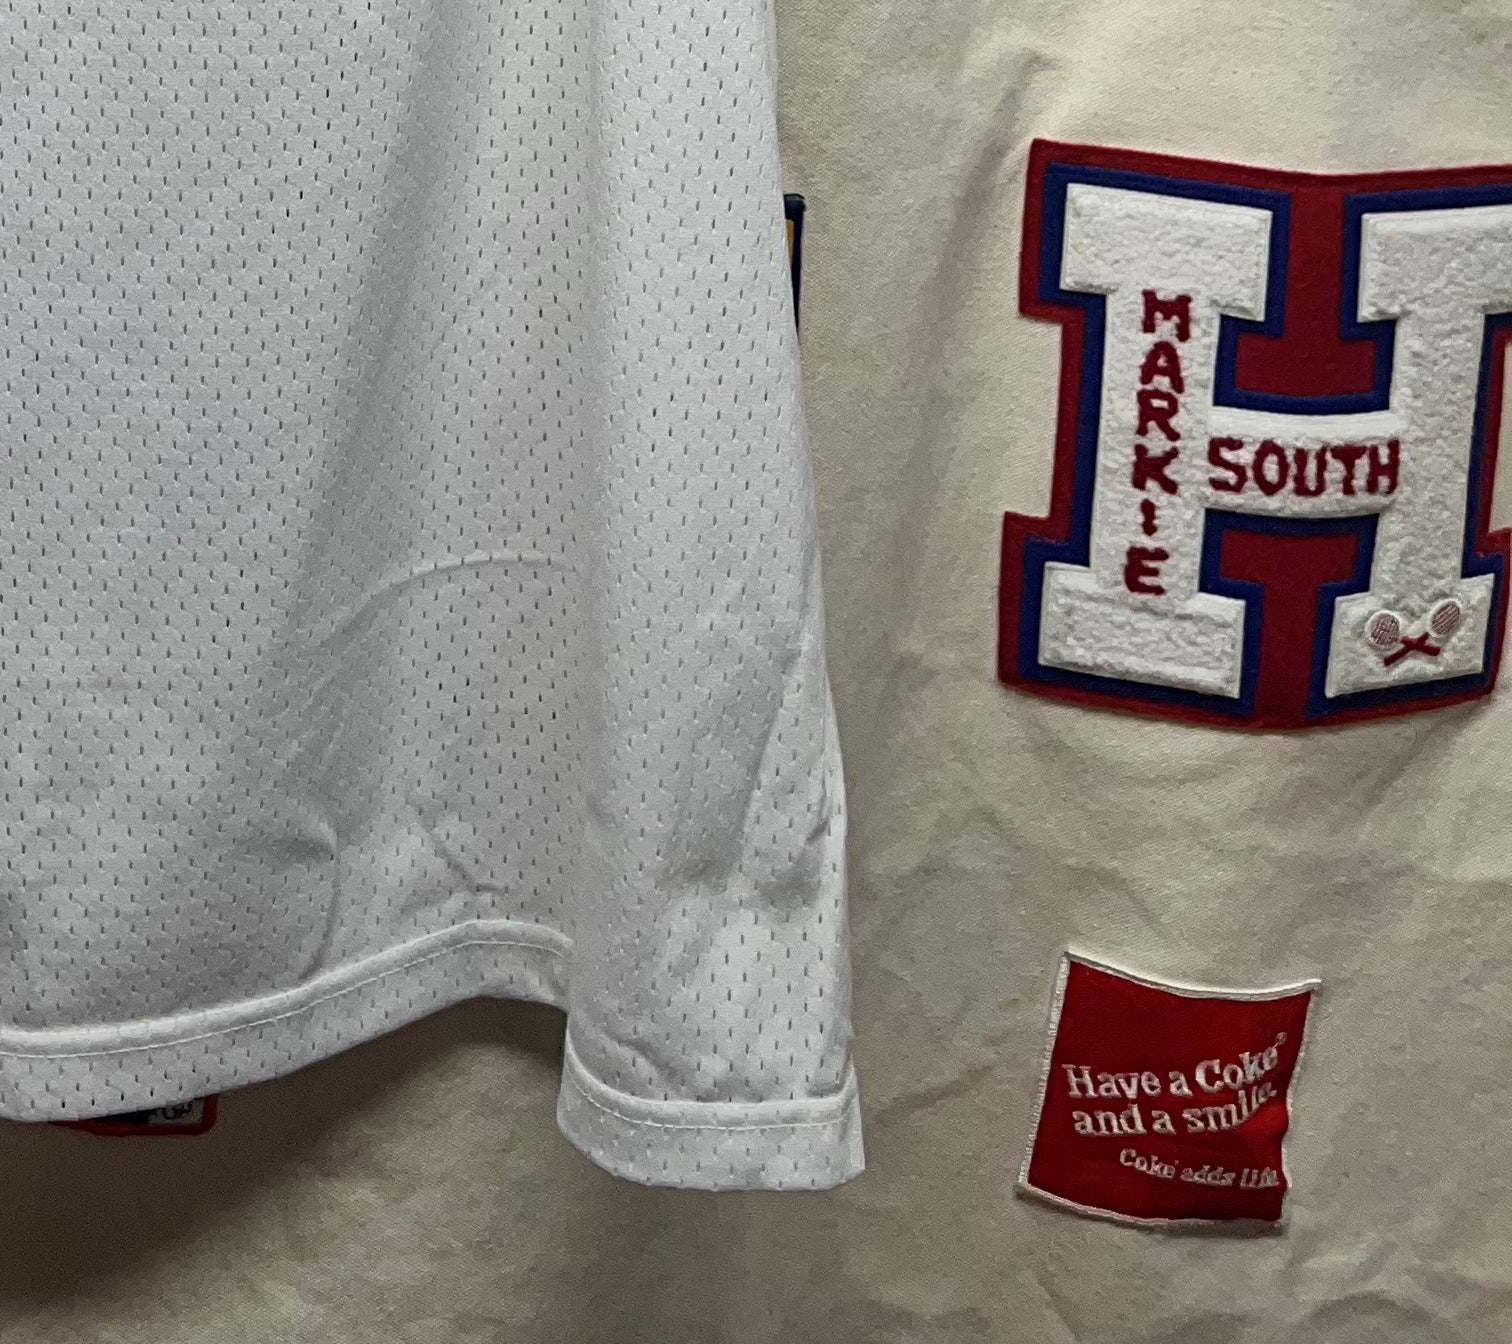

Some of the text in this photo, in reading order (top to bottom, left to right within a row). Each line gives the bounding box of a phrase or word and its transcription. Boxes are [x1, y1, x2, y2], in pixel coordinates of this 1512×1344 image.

[1123, 288, 1193, 597] MARKIE
[1206, 436, 1401, 498] SOUTH
[1061, 1063, 1162, 1099] Have
[1168, 1071, 1193, 1097] a
[1071, 1103, 1147, 1137] and
[1151, 1110, 1176, 1135] a
